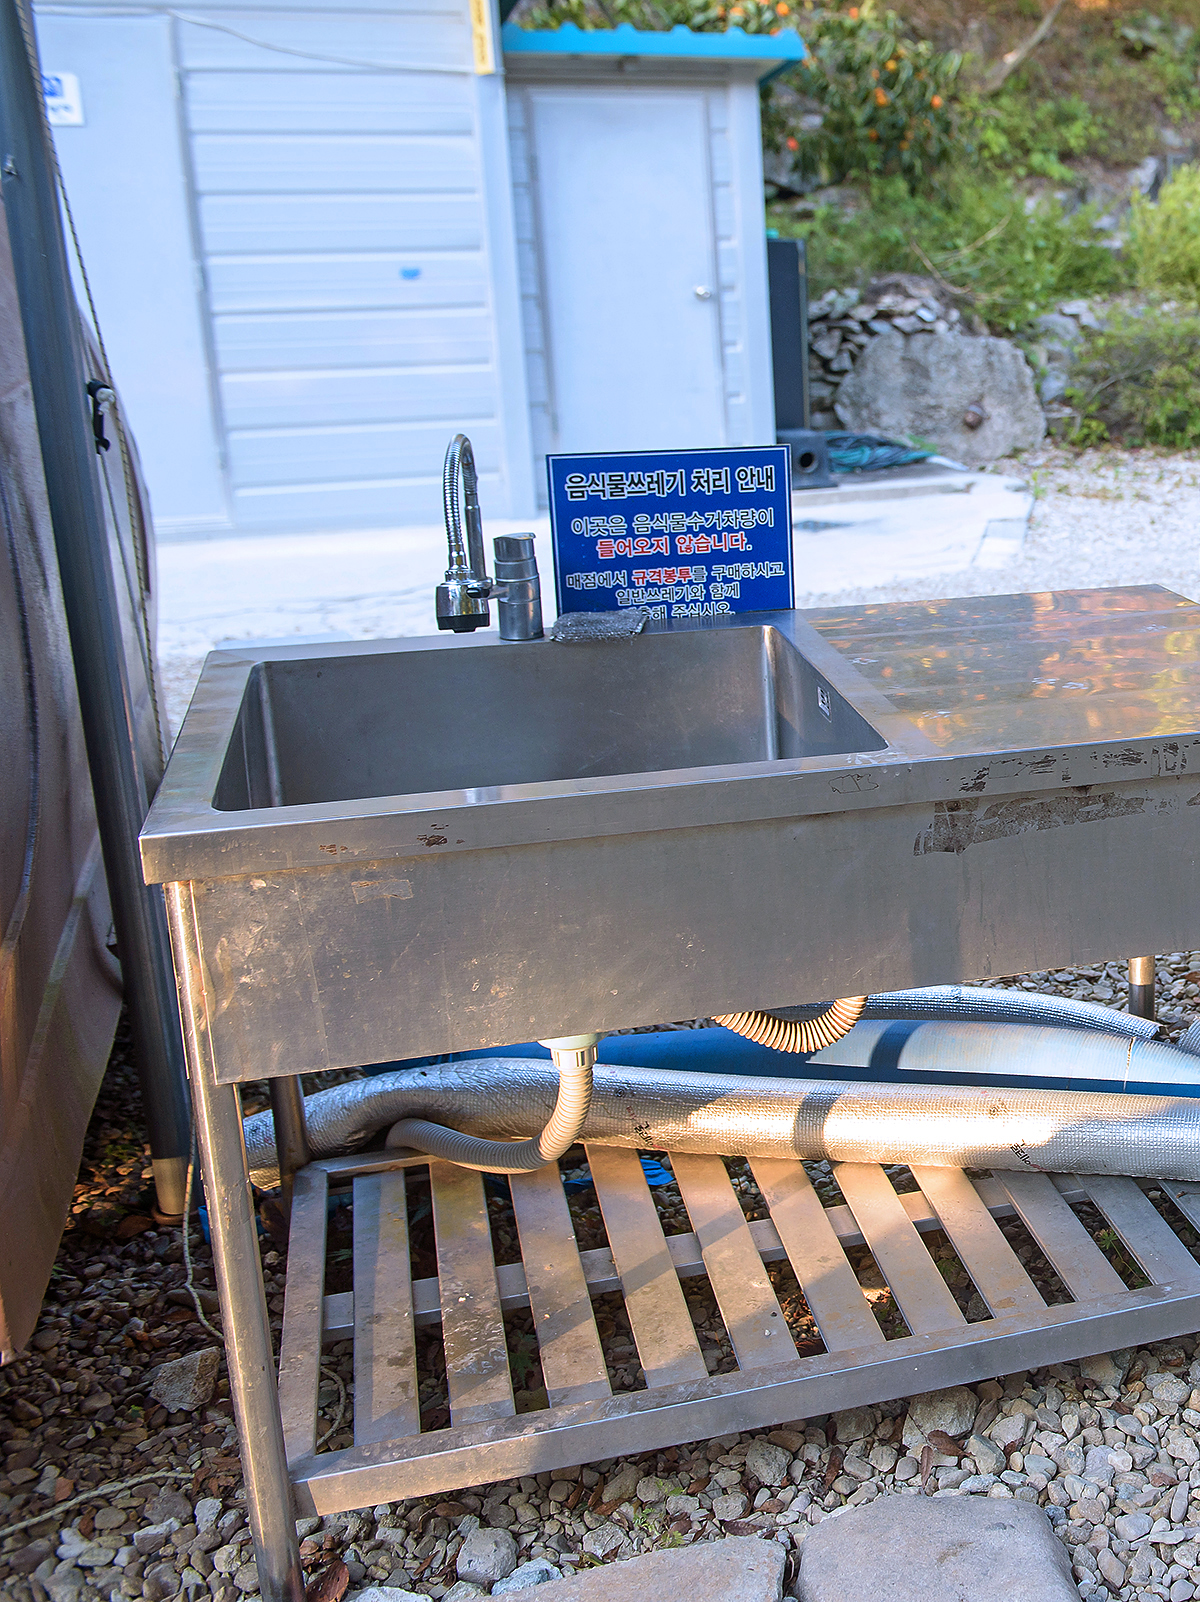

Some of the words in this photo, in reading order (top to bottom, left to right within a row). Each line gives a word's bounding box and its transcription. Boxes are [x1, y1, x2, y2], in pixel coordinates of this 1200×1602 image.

[565, 469, 685, 501] 음식물쓰레기
[691, 467, 730, 495] 처리
[735, 465, 775, 493] 안내
[572, 514, 627, 537] 이곳은
[633, 508, 774, 534] 음식물수거차량이
[597, 536, 670, 559] 들어오지
[675, 532, 752, 554] 않습니다.
[566, 571, 627, 590] 매점에서
[632, 566, 707, 586] 규격봉투를
[711, 561, 785, 581] 구매하시고
[616, 586, 705, 605] 일반쓰레기와
[709, 582, 740, 600] 함께
